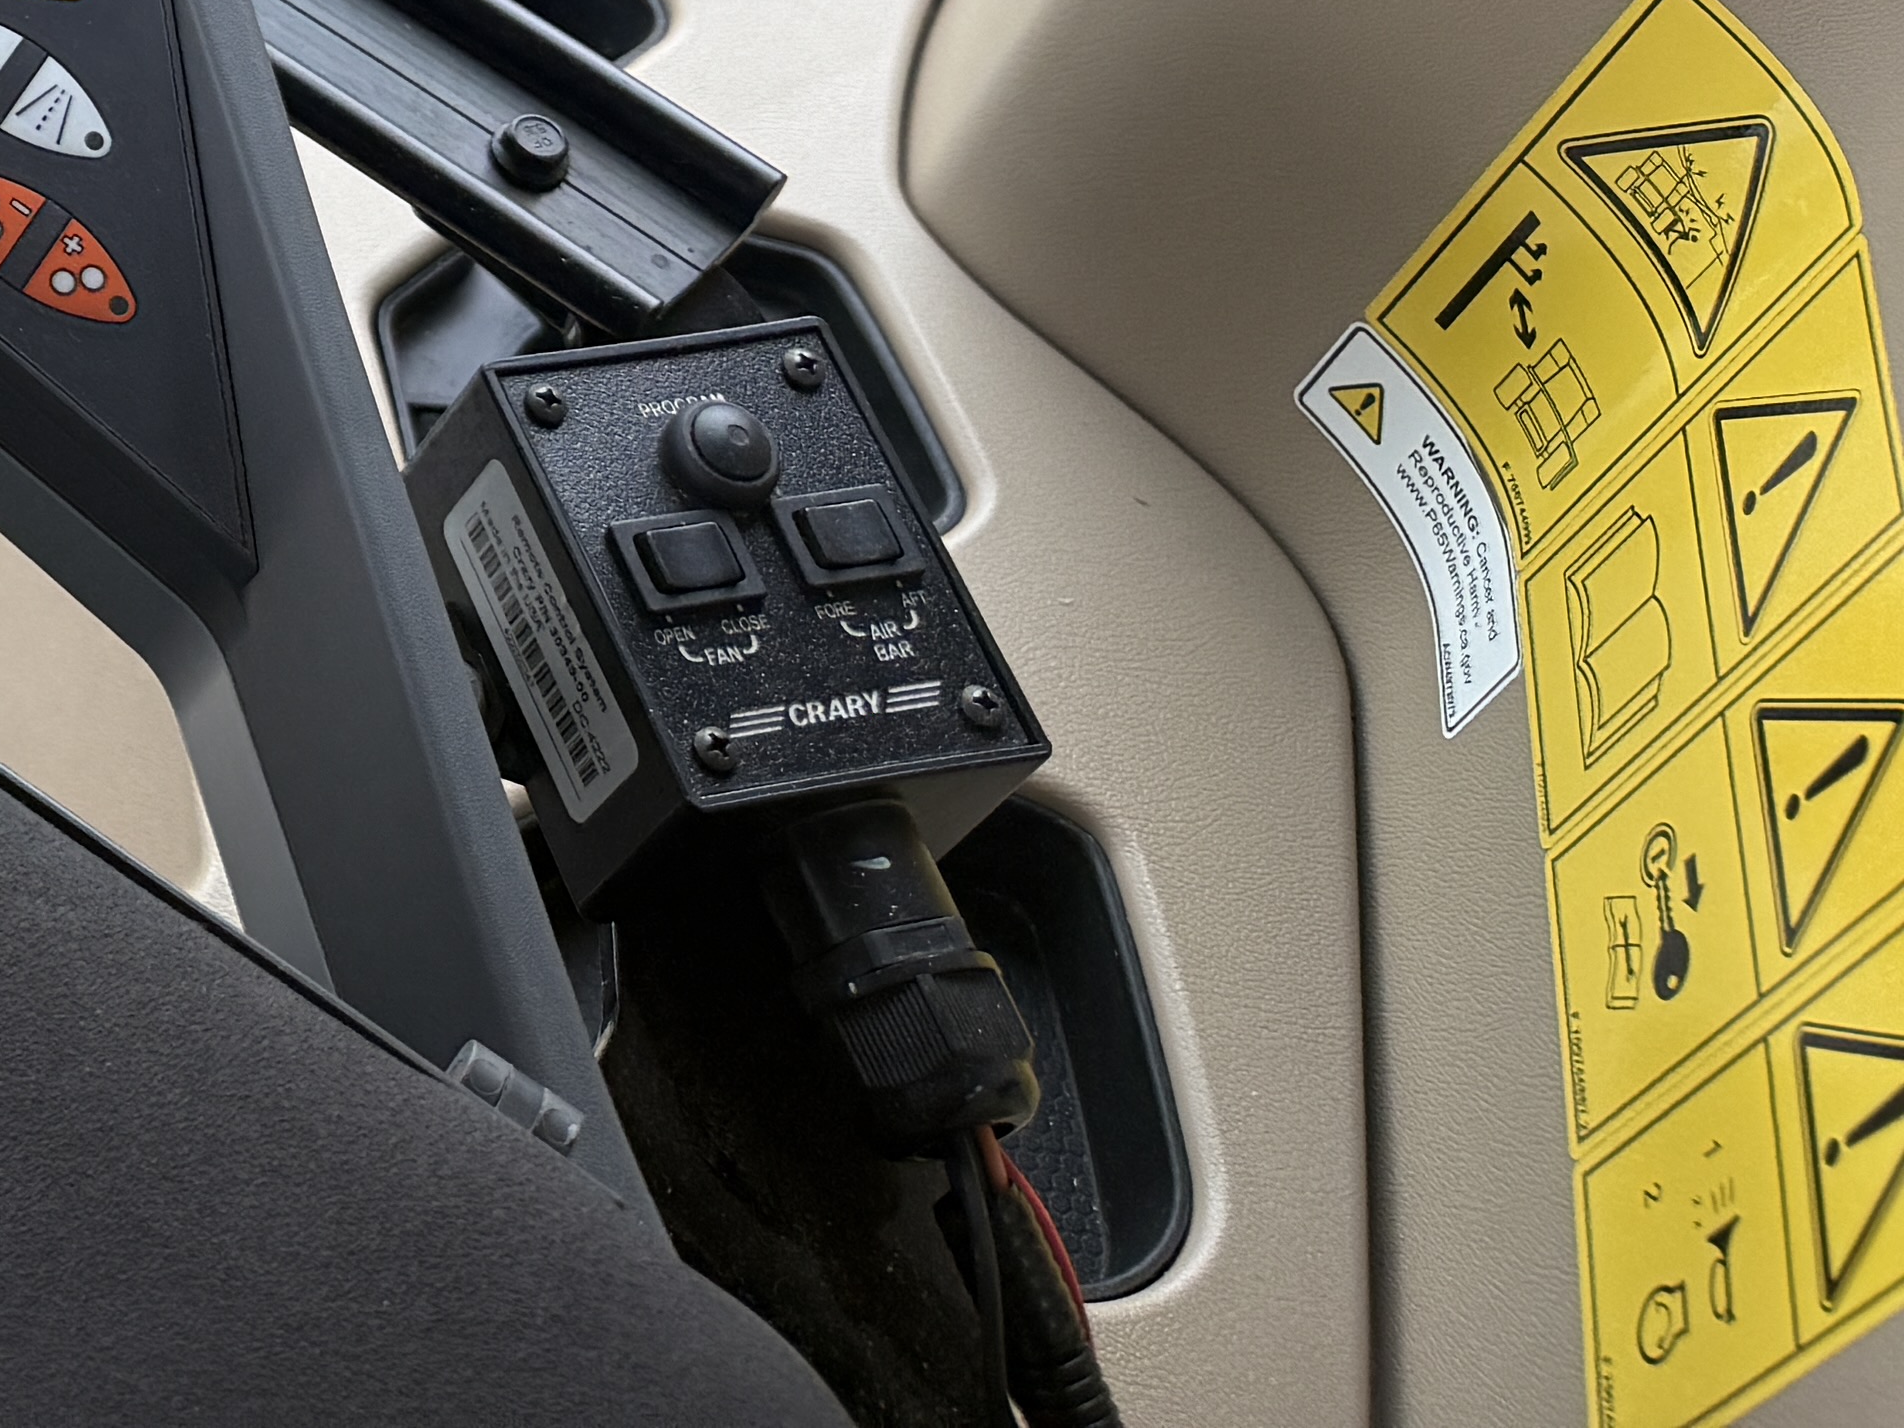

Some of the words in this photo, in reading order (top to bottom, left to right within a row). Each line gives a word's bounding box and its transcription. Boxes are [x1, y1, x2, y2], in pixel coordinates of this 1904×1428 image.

[1421, 434, 1480, 540] WARNING:
[1407, 449, 1472, 567] Reproductive
[512, 546, 537, 592] Crary
[814, 600, 858, 620] FORE
[900, 591, 928, 607] AFT
[511, 514, 544, 580] Remote
[543, 581, 577, 646] Control
[574, 645, 607, 714] System
[721, 614, 770, 635] CLOSE
[653, 625, 696, 646] OPEN
[869, 621, 902, 641] AIR
[703, 645, 744, 666] FAN
[873, 640, 915, 662] BAR
[788, 690, 882, 727] CRARY
[1643, 1181, 1662, 1209] 2
